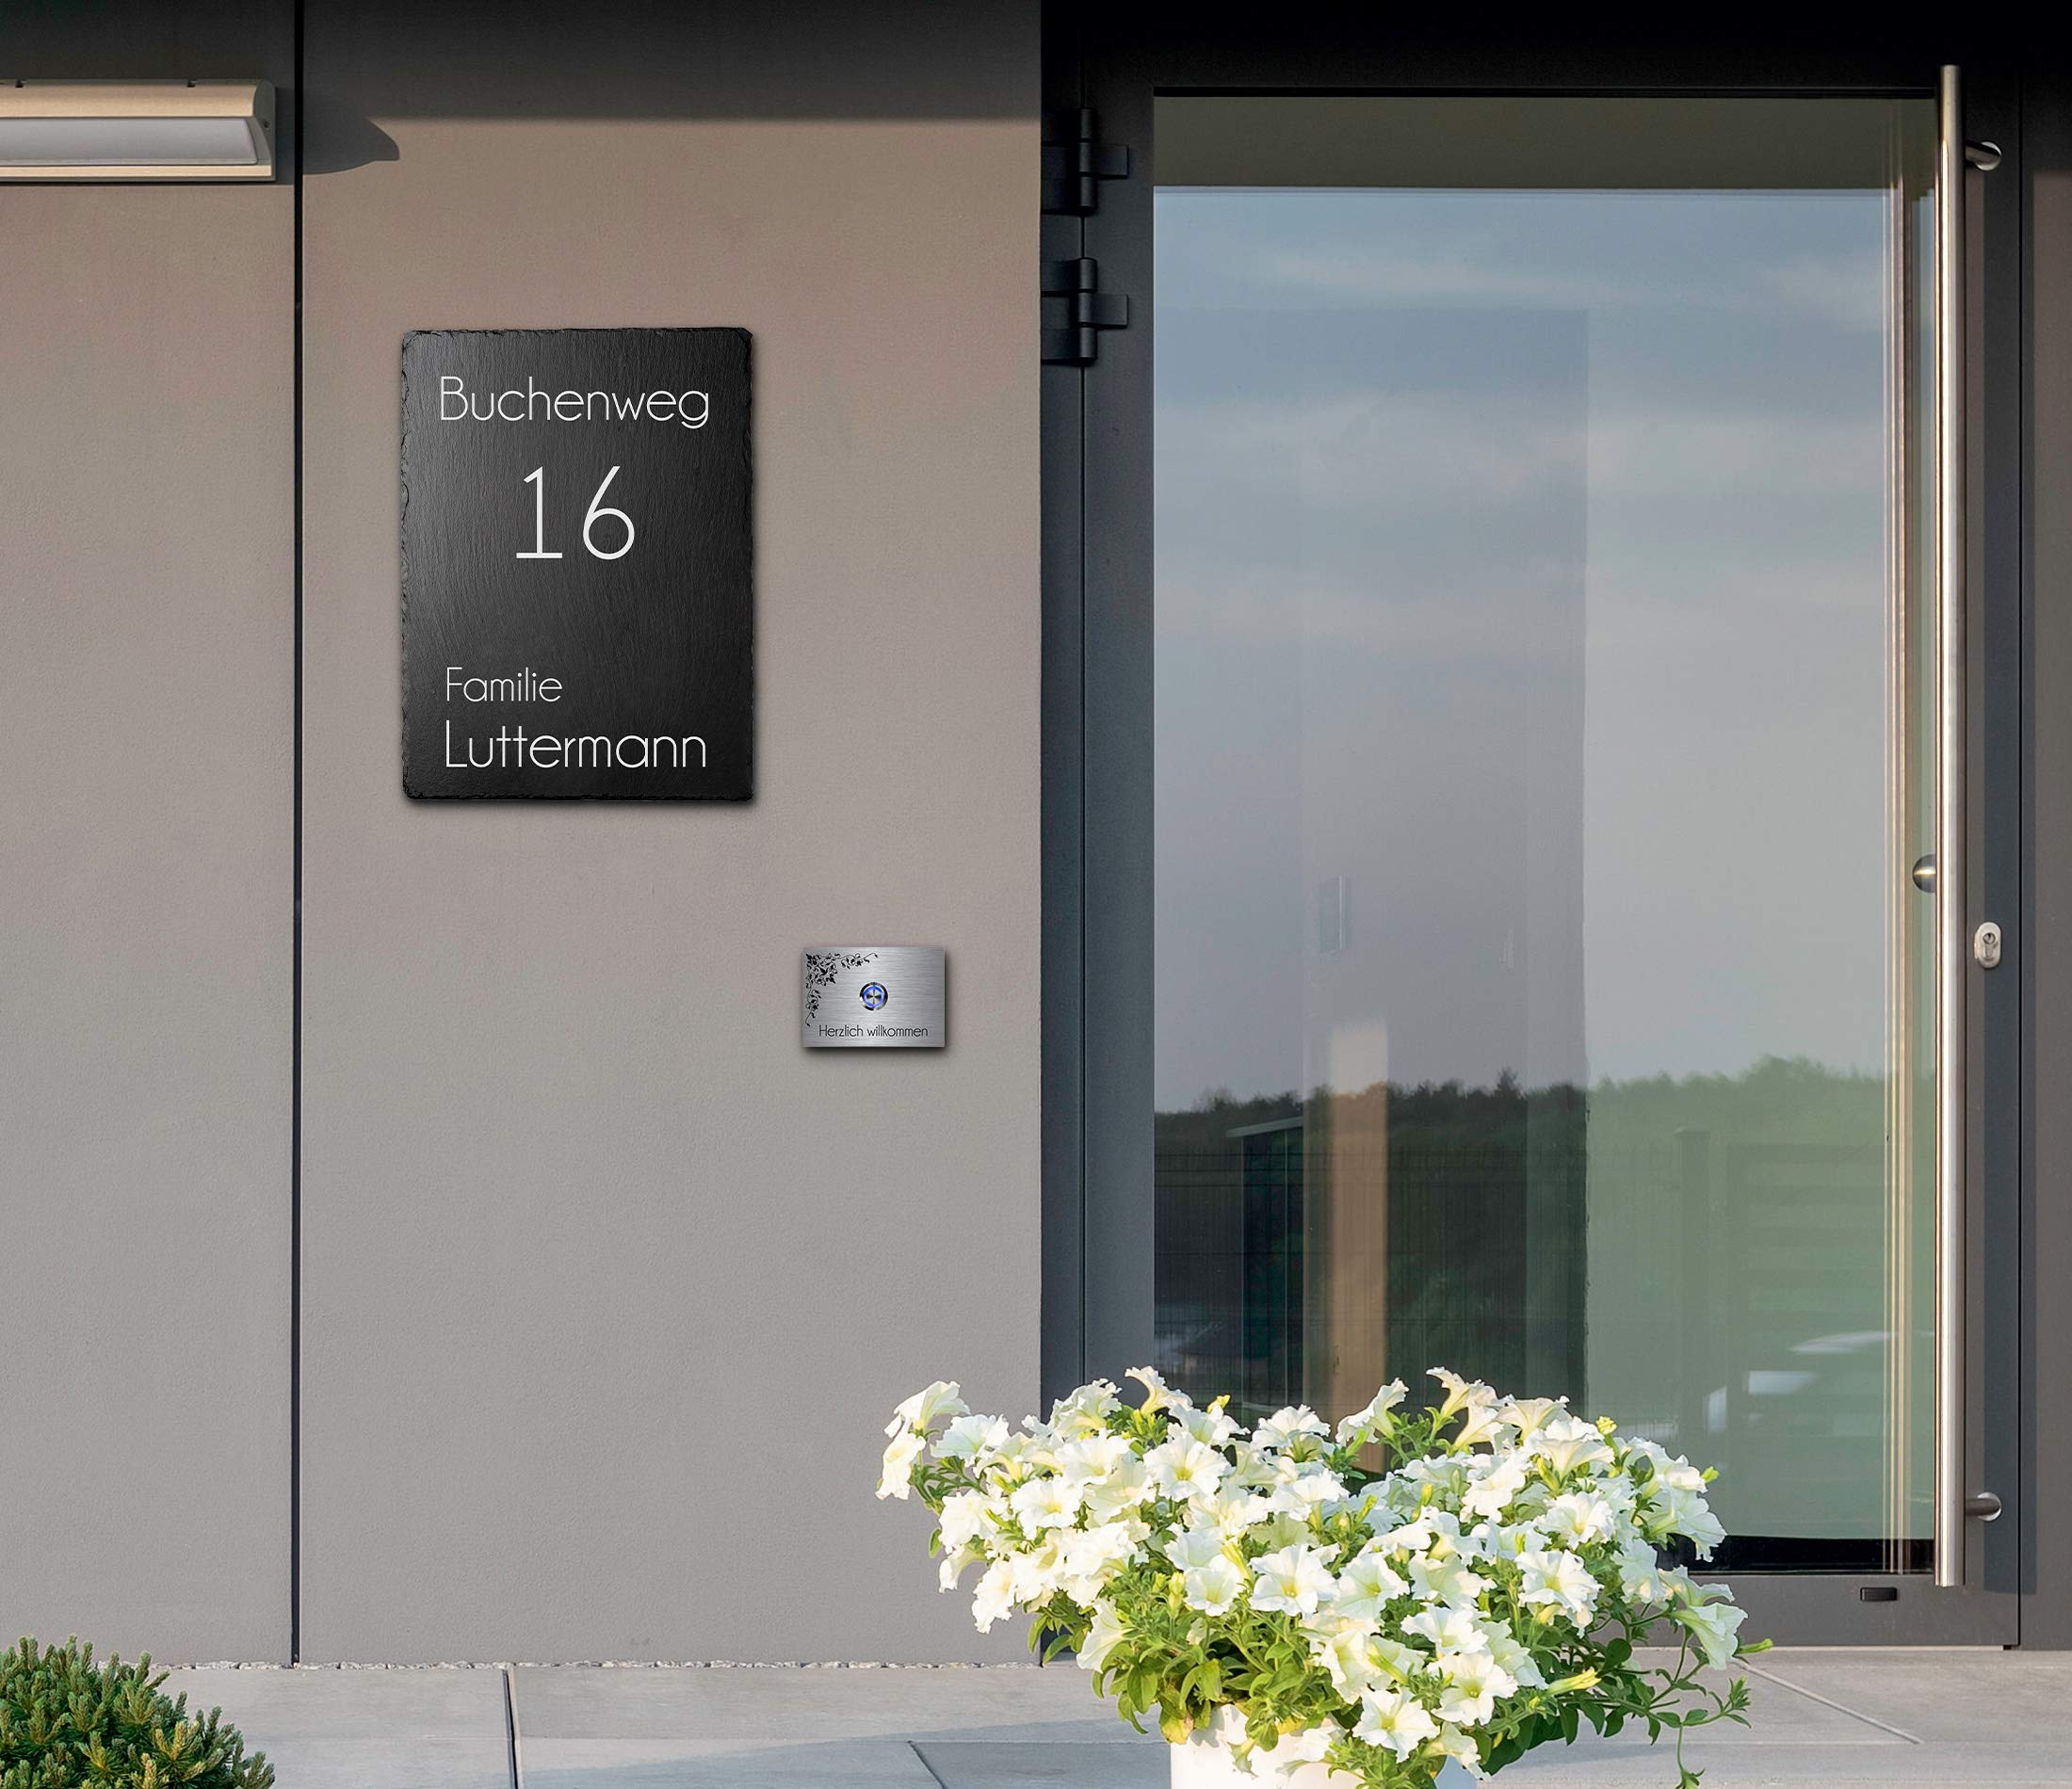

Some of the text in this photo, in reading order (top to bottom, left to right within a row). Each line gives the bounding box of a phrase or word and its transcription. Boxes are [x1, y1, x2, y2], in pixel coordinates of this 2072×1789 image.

[440, 376, 709, 429] Buchenweg
[515, 465, 635, 560] 16
[446, 667, 563, 702] Familie
[445, 719, 706, 768] Luttermann
[818, 1024, 929, 1038] Herzlich willkommen
